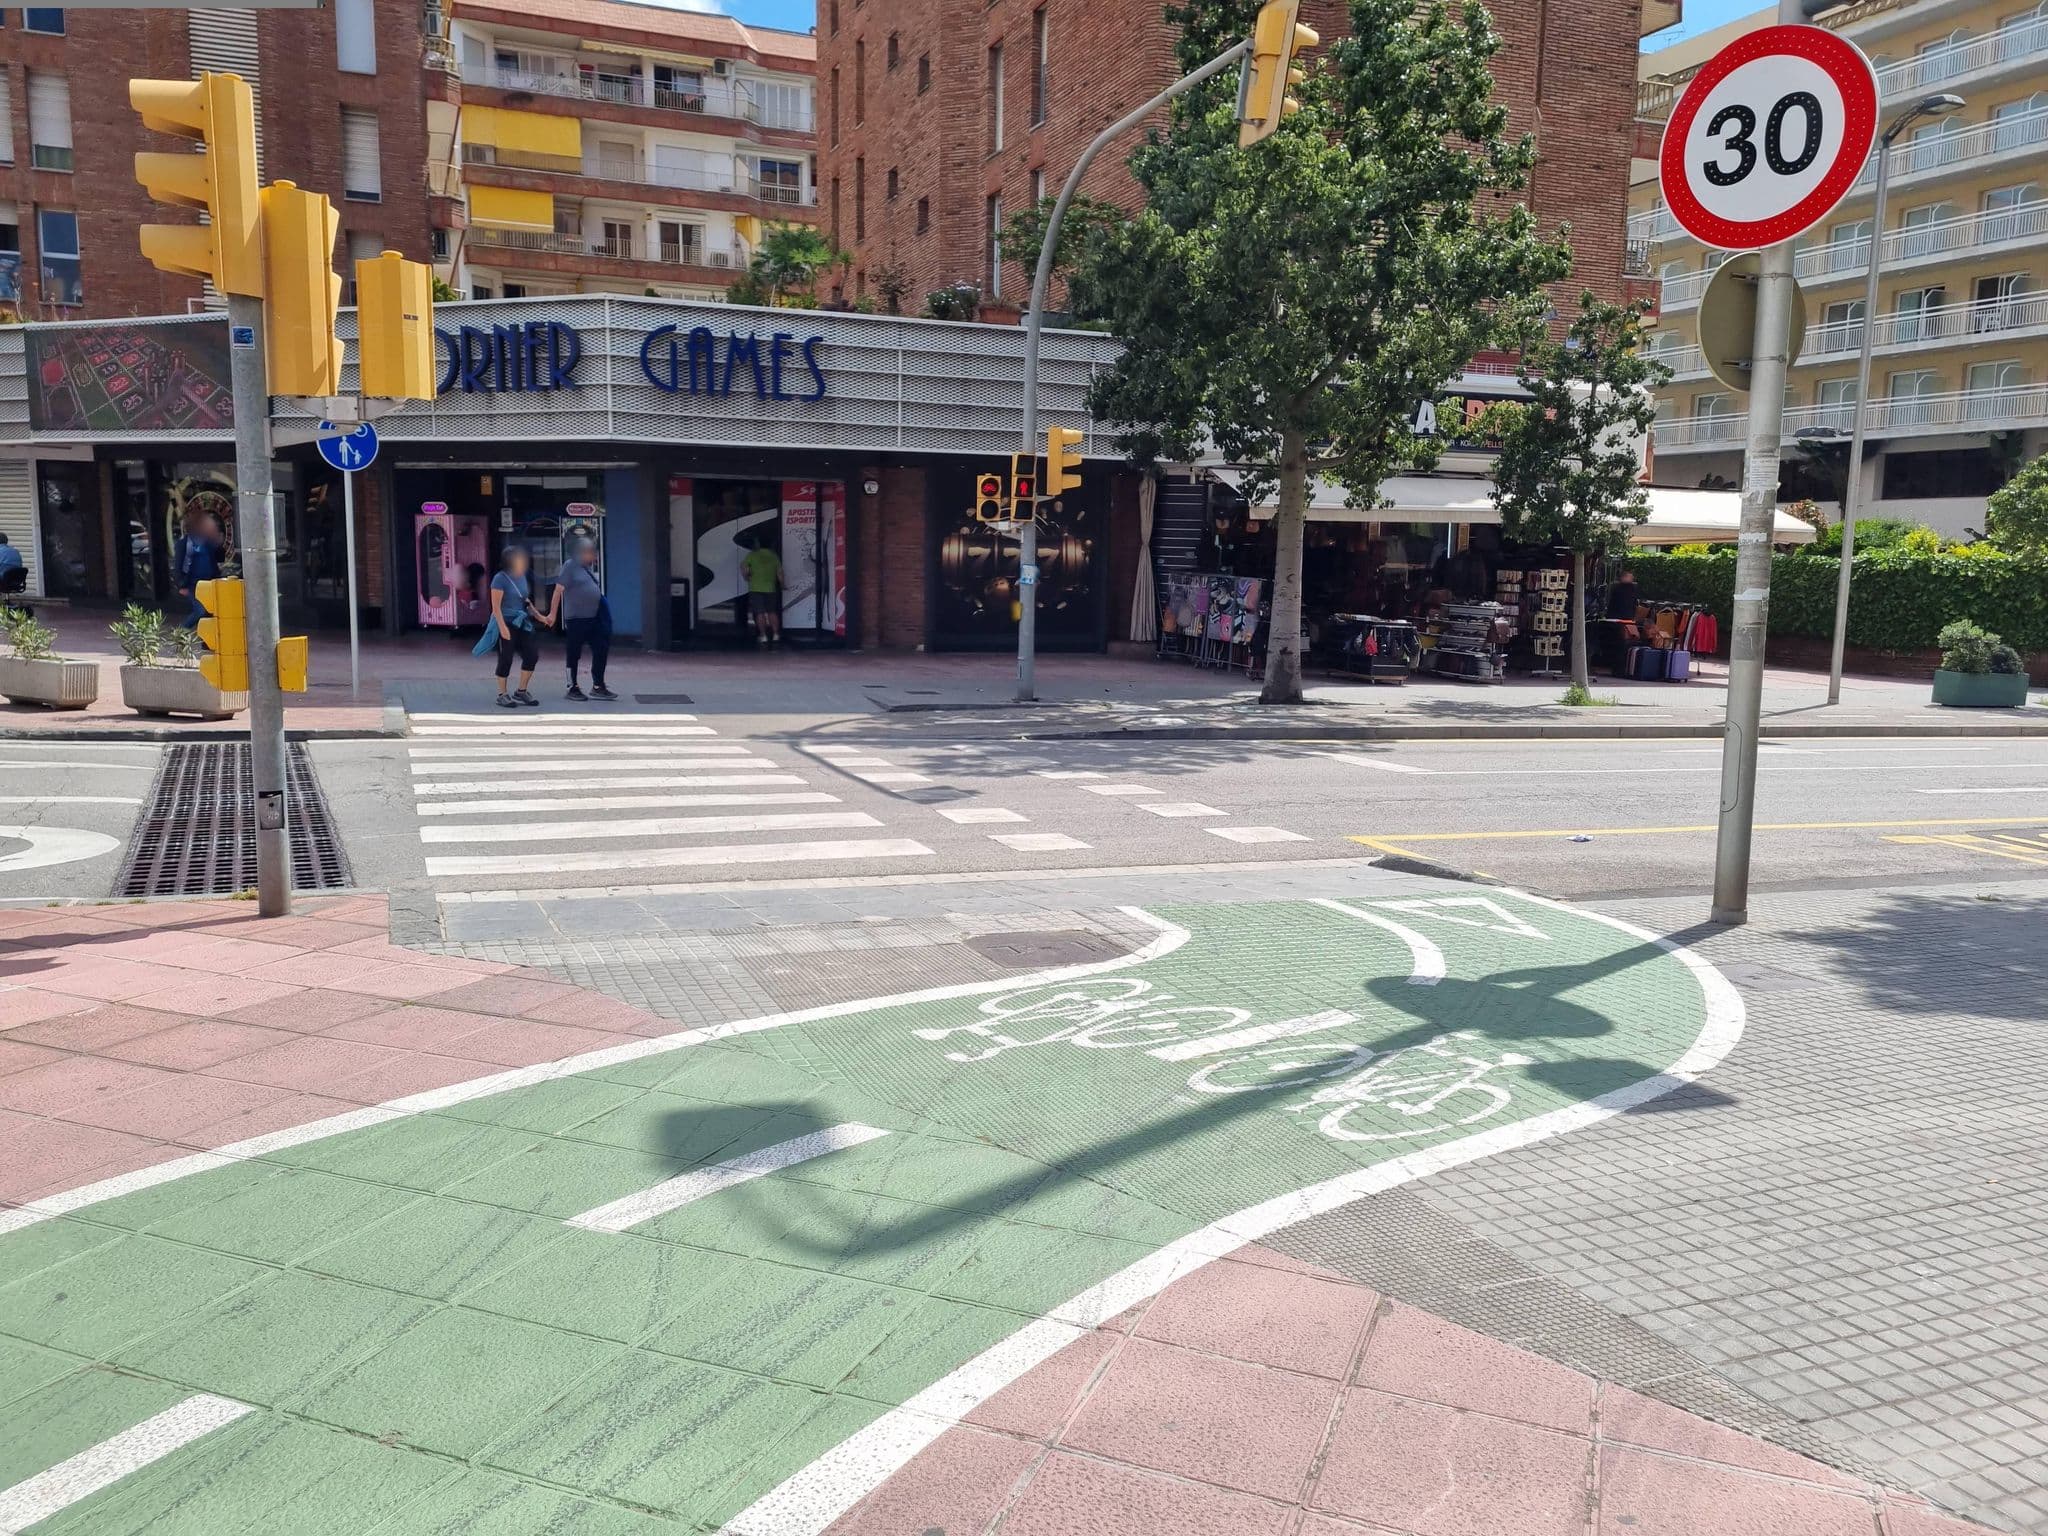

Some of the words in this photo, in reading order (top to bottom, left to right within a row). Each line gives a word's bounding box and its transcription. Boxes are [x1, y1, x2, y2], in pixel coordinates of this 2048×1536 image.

[1703, 91, 1823, 187] 30
[640, 323, 826, 402] GAMES
[122, 393, 144, 413] 25
